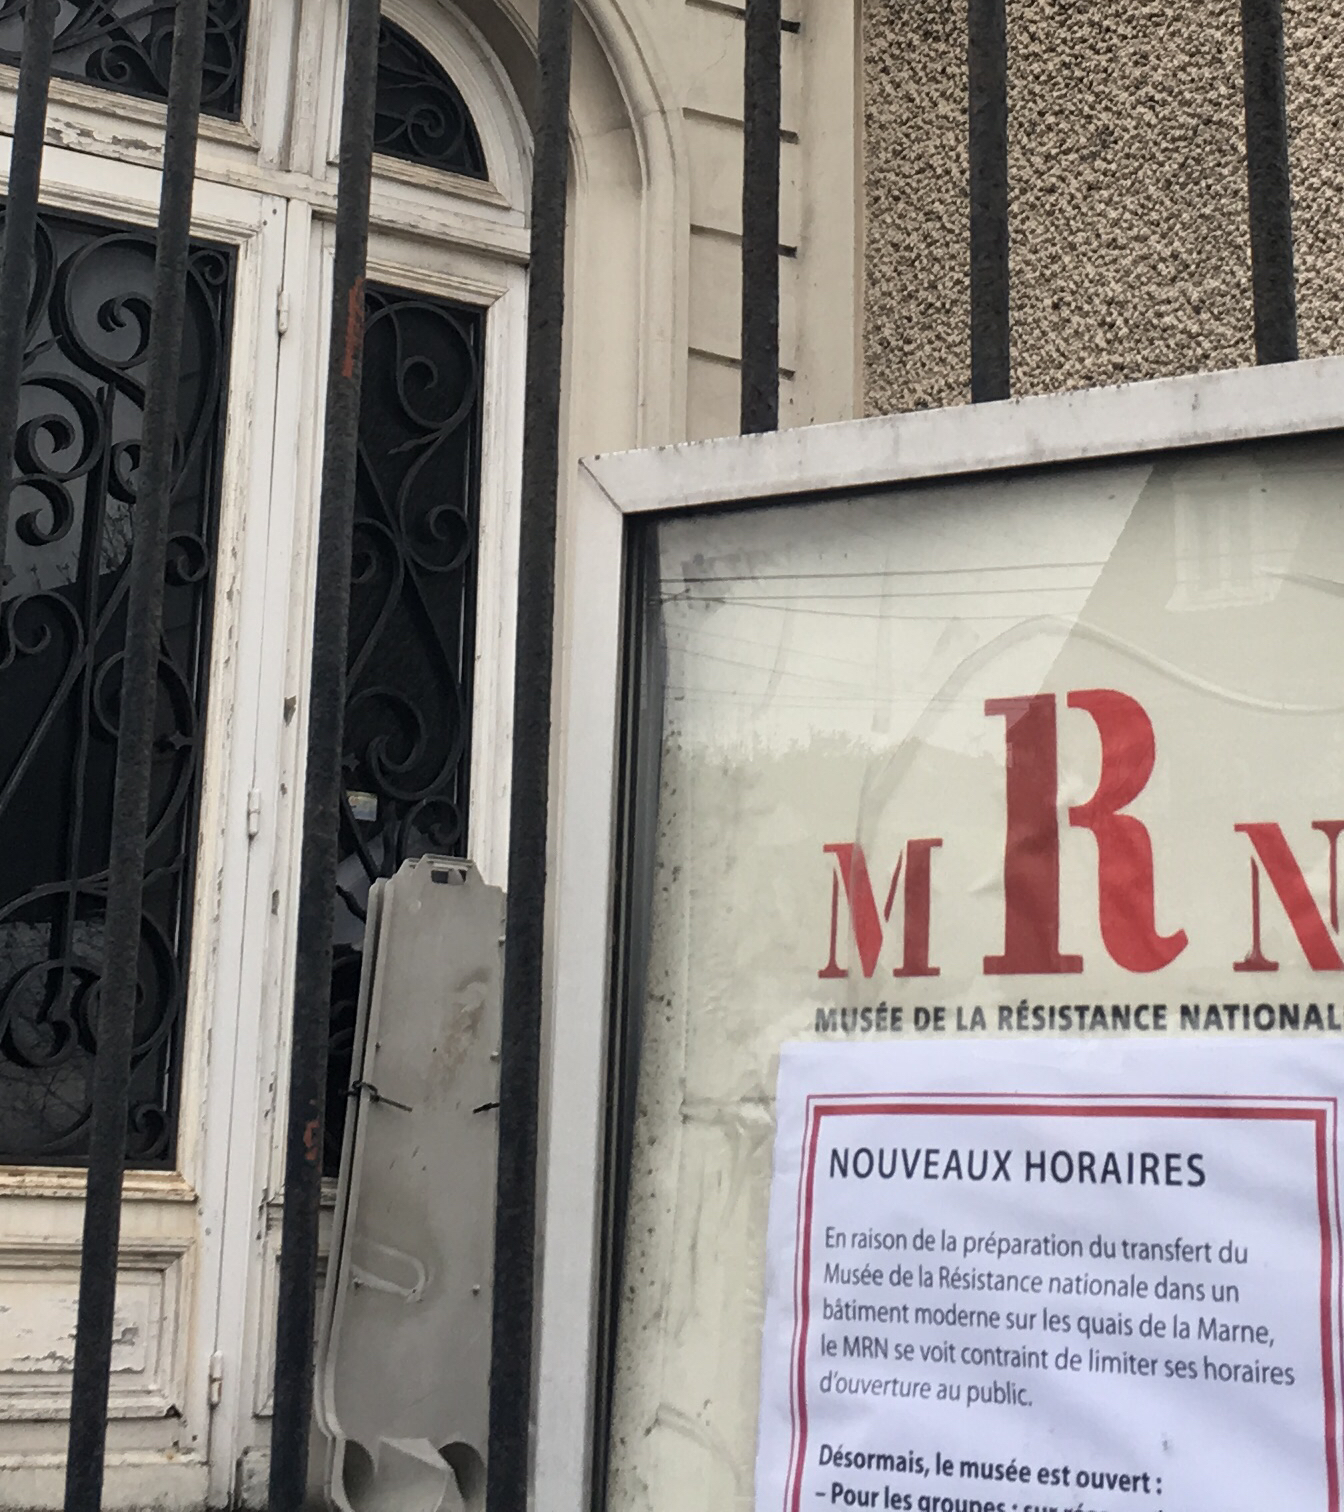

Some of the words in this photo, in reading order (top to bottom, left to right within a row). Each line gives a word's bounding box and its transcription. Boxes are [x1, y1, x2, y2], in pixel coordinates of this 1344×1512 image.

[815, 1002, 904, 1034] MUSÉE
[914, 1005, 946, 1033] DE
[957, 1005, 987, 1032] LA
[997, 999, 1168, 1032] RÉSISTANCE
[829, 1147, 1012, 1182] NOUVEAUX
[1025, 1150, 1206, 1188] HORAIRES
[825, 1226, 846, 1249] En
[851, 1228, 907, 1251] raison
[912, 1228, 936, 1252] de
[941, 1229, 956, 1252] la
[963, 1231, 1083, 1259] préparation
[1089, 1234, 1116, 1259] du
[1121, 1237, 1212, 1263] transfert
[1218, 1239, 1248, 1264] du
[824, 1262, 883, 1286] Musée
[889, 1264, 913, 1287] de
[918, 1264, 933, 1288] la
[939, 1266, 1043, 1293] Résistance
[1048, 1273, 1148, 1299] nationale
[1154, 1275, 1205, 1302] dans
[1211, 1283, 1239, 1303] un
[823, 1297, 909, 1324] bâtiment
[914, 1303, 1001, 1329] moderne
[1006, 1312, 1037, 1330] sur
[1043, 1307, 1071, 1333] les
[1076, 1312, 1133, 1339] quais
[1139, 1313, 1166, 1338] de
[1173, 1314, 1190, 1339] la
[1197, 1317, 1275, 1348] Marne,
[821, 1333, 837, 1357] le
[843, 1335, 888, 1360] MRN
[894, 1342, 914, 1361] se
[920, 1341, 956, 1364] voit
[961, 1344, 1049, 1370] contraint
[1055, 1347, 1082, 1372] de
[1088, 1348, 1159, 1377] limiter
[1164, 1359, 1198, 1379] ses
[1203, 1355, 1296, 1386] horaires
[937, 1382, 961, 1402] au
[967, 1380, 1033, 1408] public.
[819, 1443, 930, 1479] Désormais,
[935, 1451, 955, 1477] le
[960, 1458, 1032, 1483] musée
[1037, 1465, 1071, 1487] est
[1076, 1469, 1151, 1495] ouvert
[831, 1481, 879, 1508] Pour
[884, 1485, 913, 1511] les
